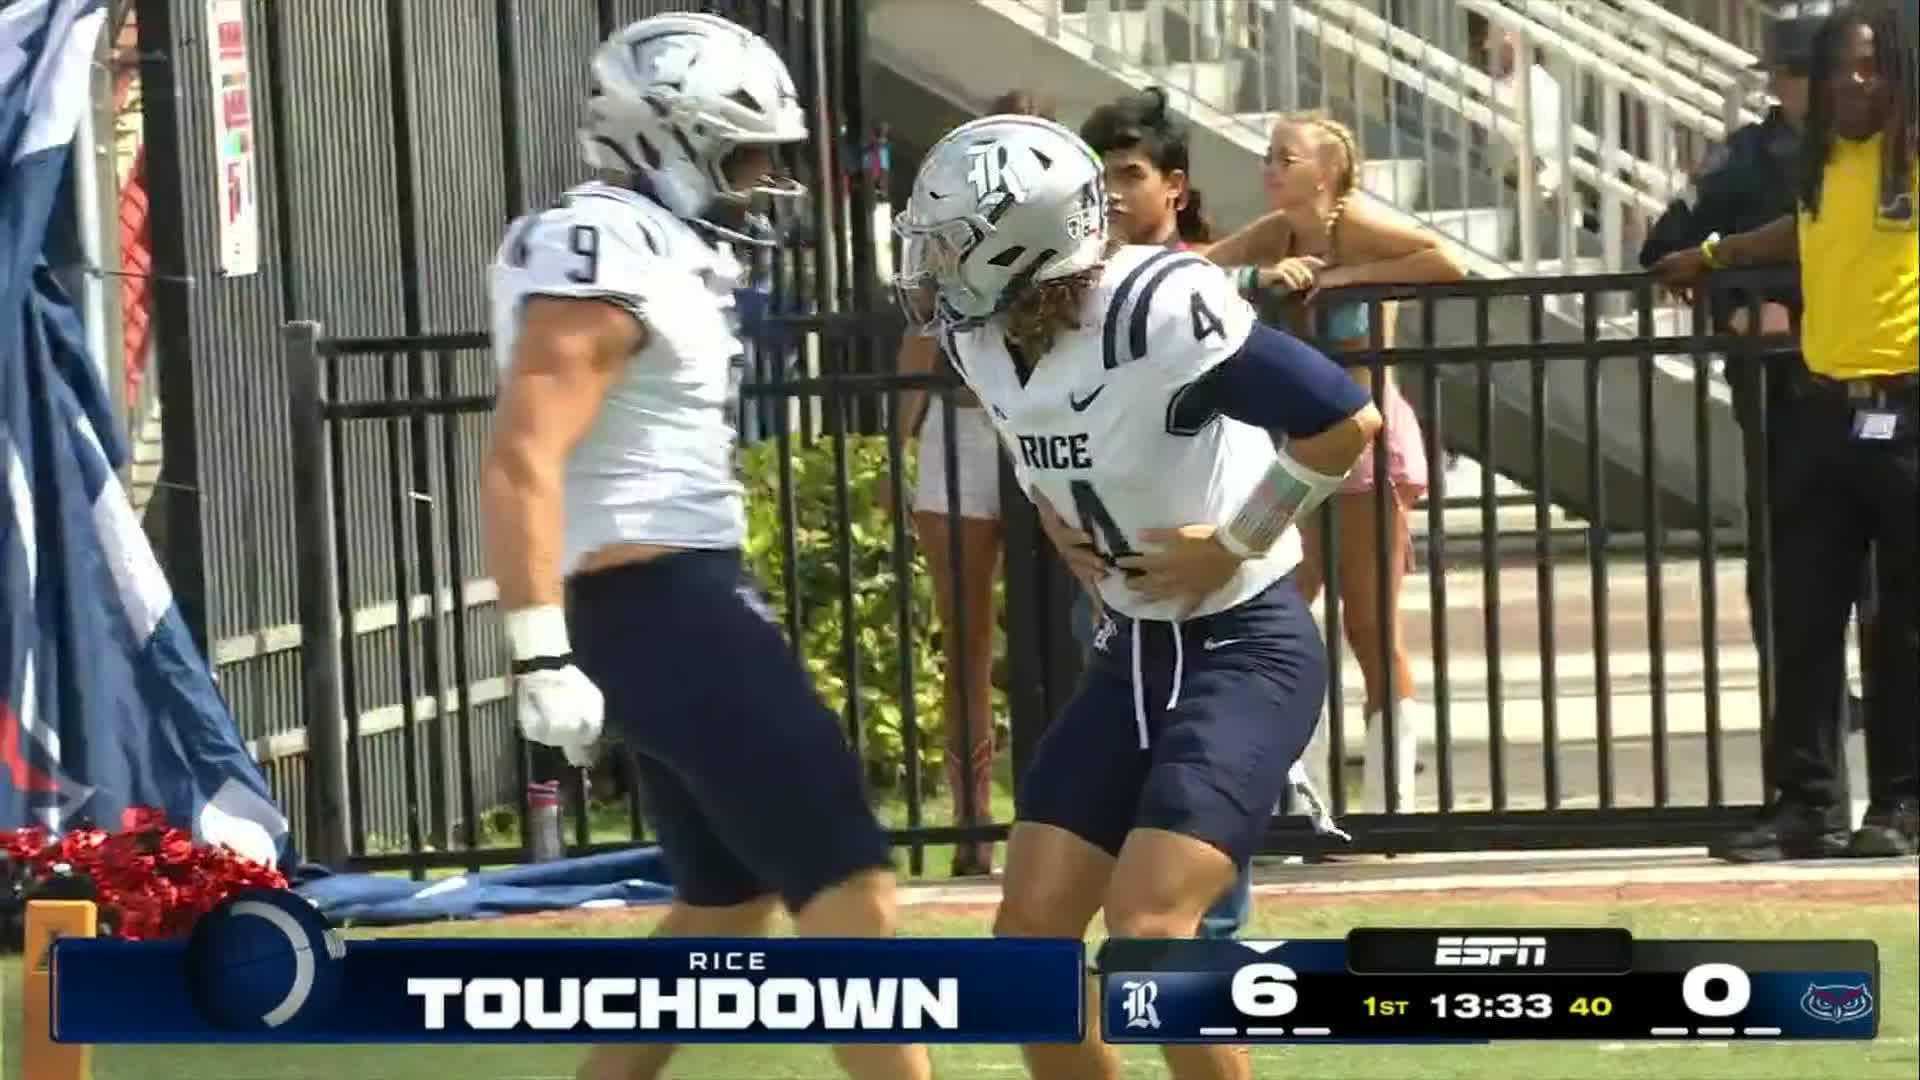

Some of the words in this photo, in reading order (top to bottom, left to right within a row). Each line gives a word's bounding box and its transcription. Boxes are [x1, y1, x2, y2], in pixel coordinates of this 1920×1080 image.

[566, 225, 599, 284] 9
[1191, 293, 1226, 342] 4
[1018, 432, 1093, 470] RICE
